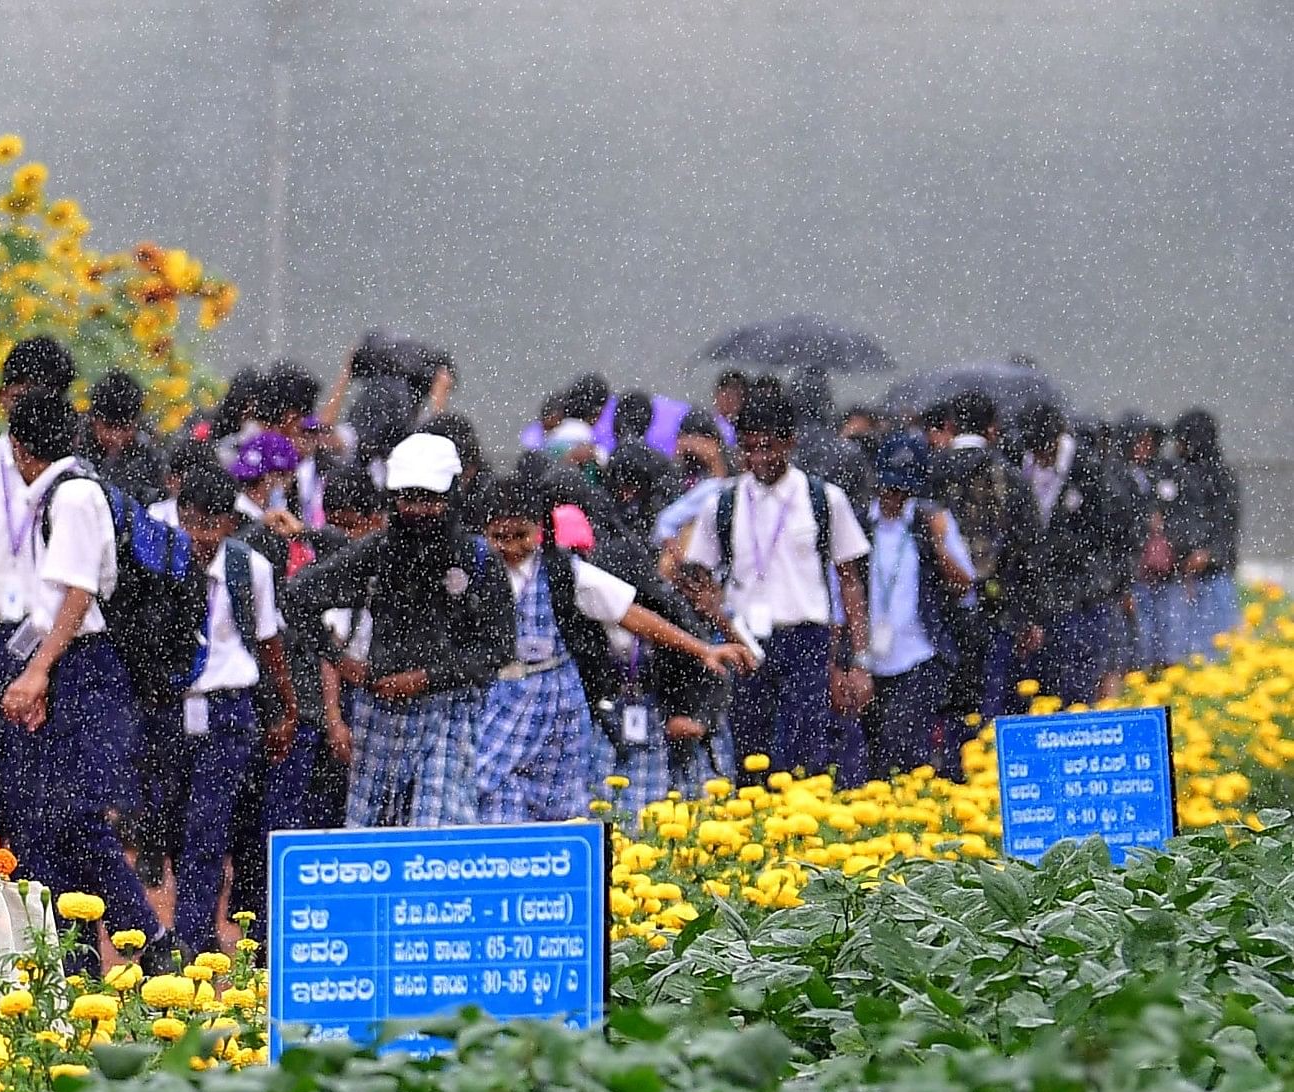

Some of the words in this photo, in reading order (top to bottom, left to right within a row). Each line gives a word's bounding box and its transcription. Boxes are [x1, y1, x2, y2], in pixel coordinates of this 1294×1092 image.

[299, 859, 392, 885] ತರಕಾರಿ
[403, 850, 571, 882] ಸೋಯಾಅವರೆ
[291, 906, 330, 931] ತಳಿ
[501, 900, 509, 922] 1
[291, 939, 349, 966] ಅವಧಿ
[486, 936, 533, 959] 65-70
[291, 976, 375, 1003] ಇಳುವರಿ
[482, 969, 527, 993] 30-35
